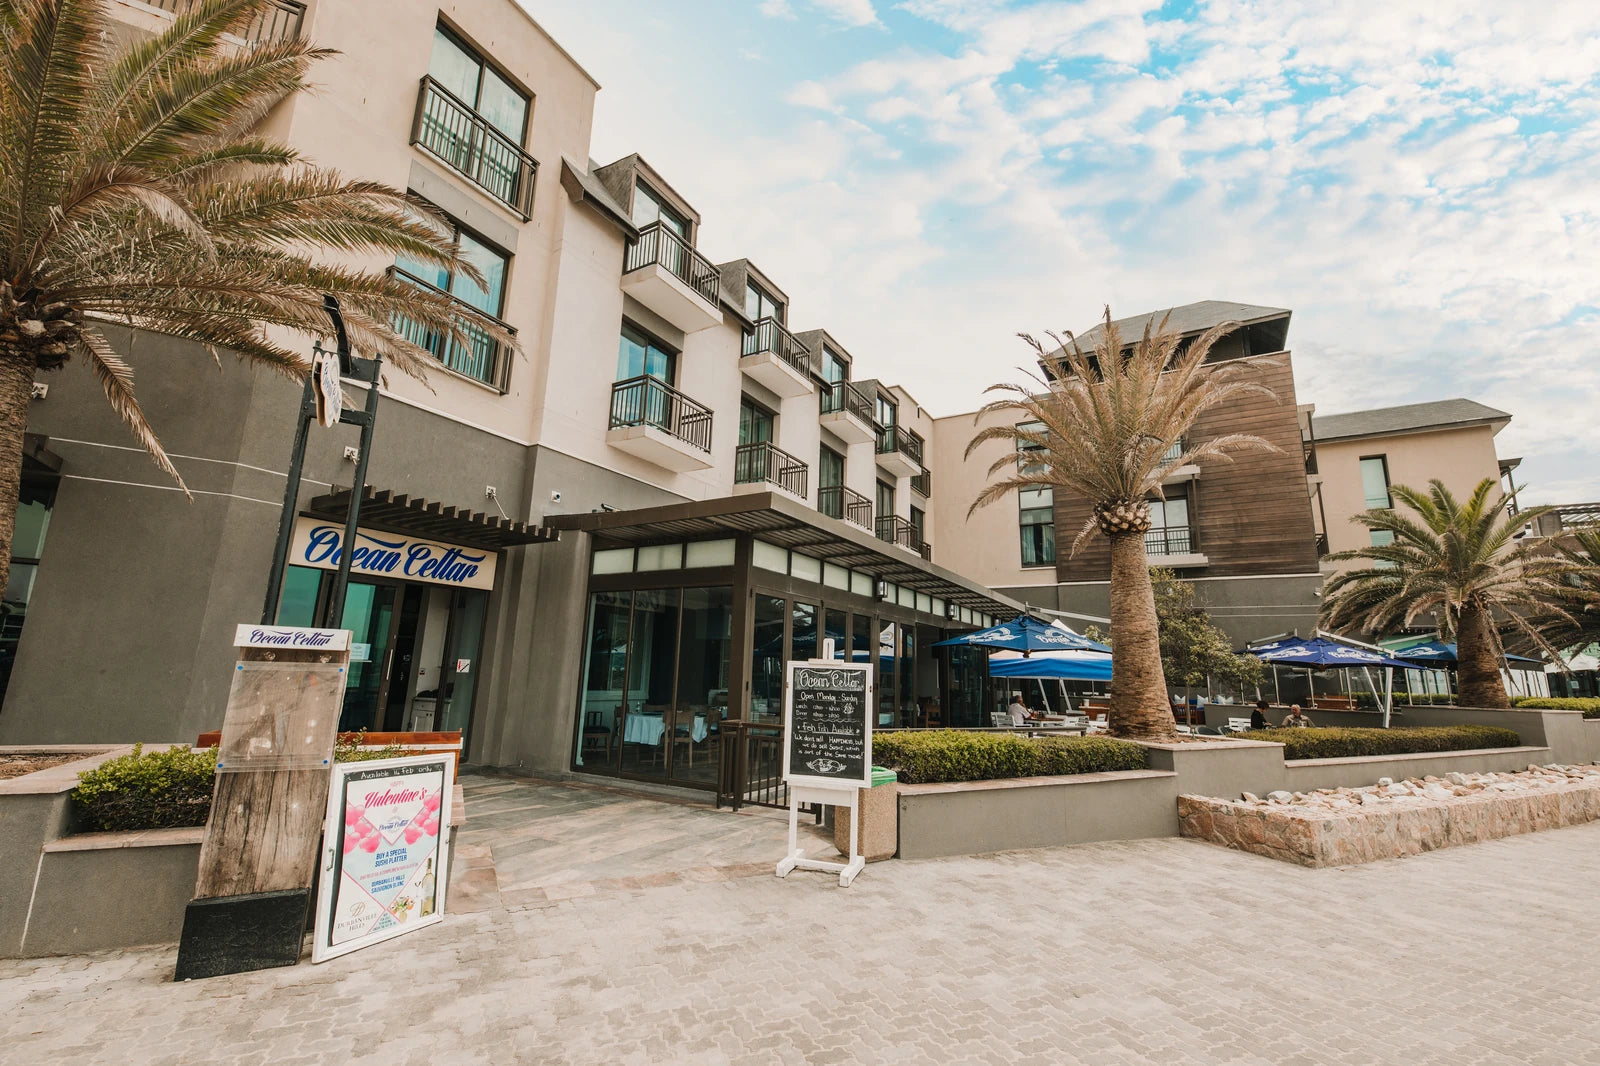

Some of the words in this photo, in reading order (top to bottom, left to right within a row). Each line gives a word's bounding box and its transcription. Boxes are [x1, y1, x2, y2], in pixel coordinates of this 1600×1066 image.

[304, 525, 407, 572] Ocean
[403, 542, 487, 583] Cellar
[249, 629, 294, 645] Ocean
[292, 631, 334, 646] Cellar
[800, 669, 832, 687] Ocean
[831, 670, 862, 687] Cellar
[801, 691, 814, 701] Open
[817, 691, 836, 704] Monday
[841, 692, 858, 705] Sunday
[401, 766, 414, 775] Feb
[418, 765, 432, 773] only
[364, 787, 428, 809] Valentine's
[375, 852, 386, 860] BUY
[389, 847, 408, 857] SPECIAL
[374, 858, 389, 868] SUSHI
[388, 855, 408, 865] PLATTER
